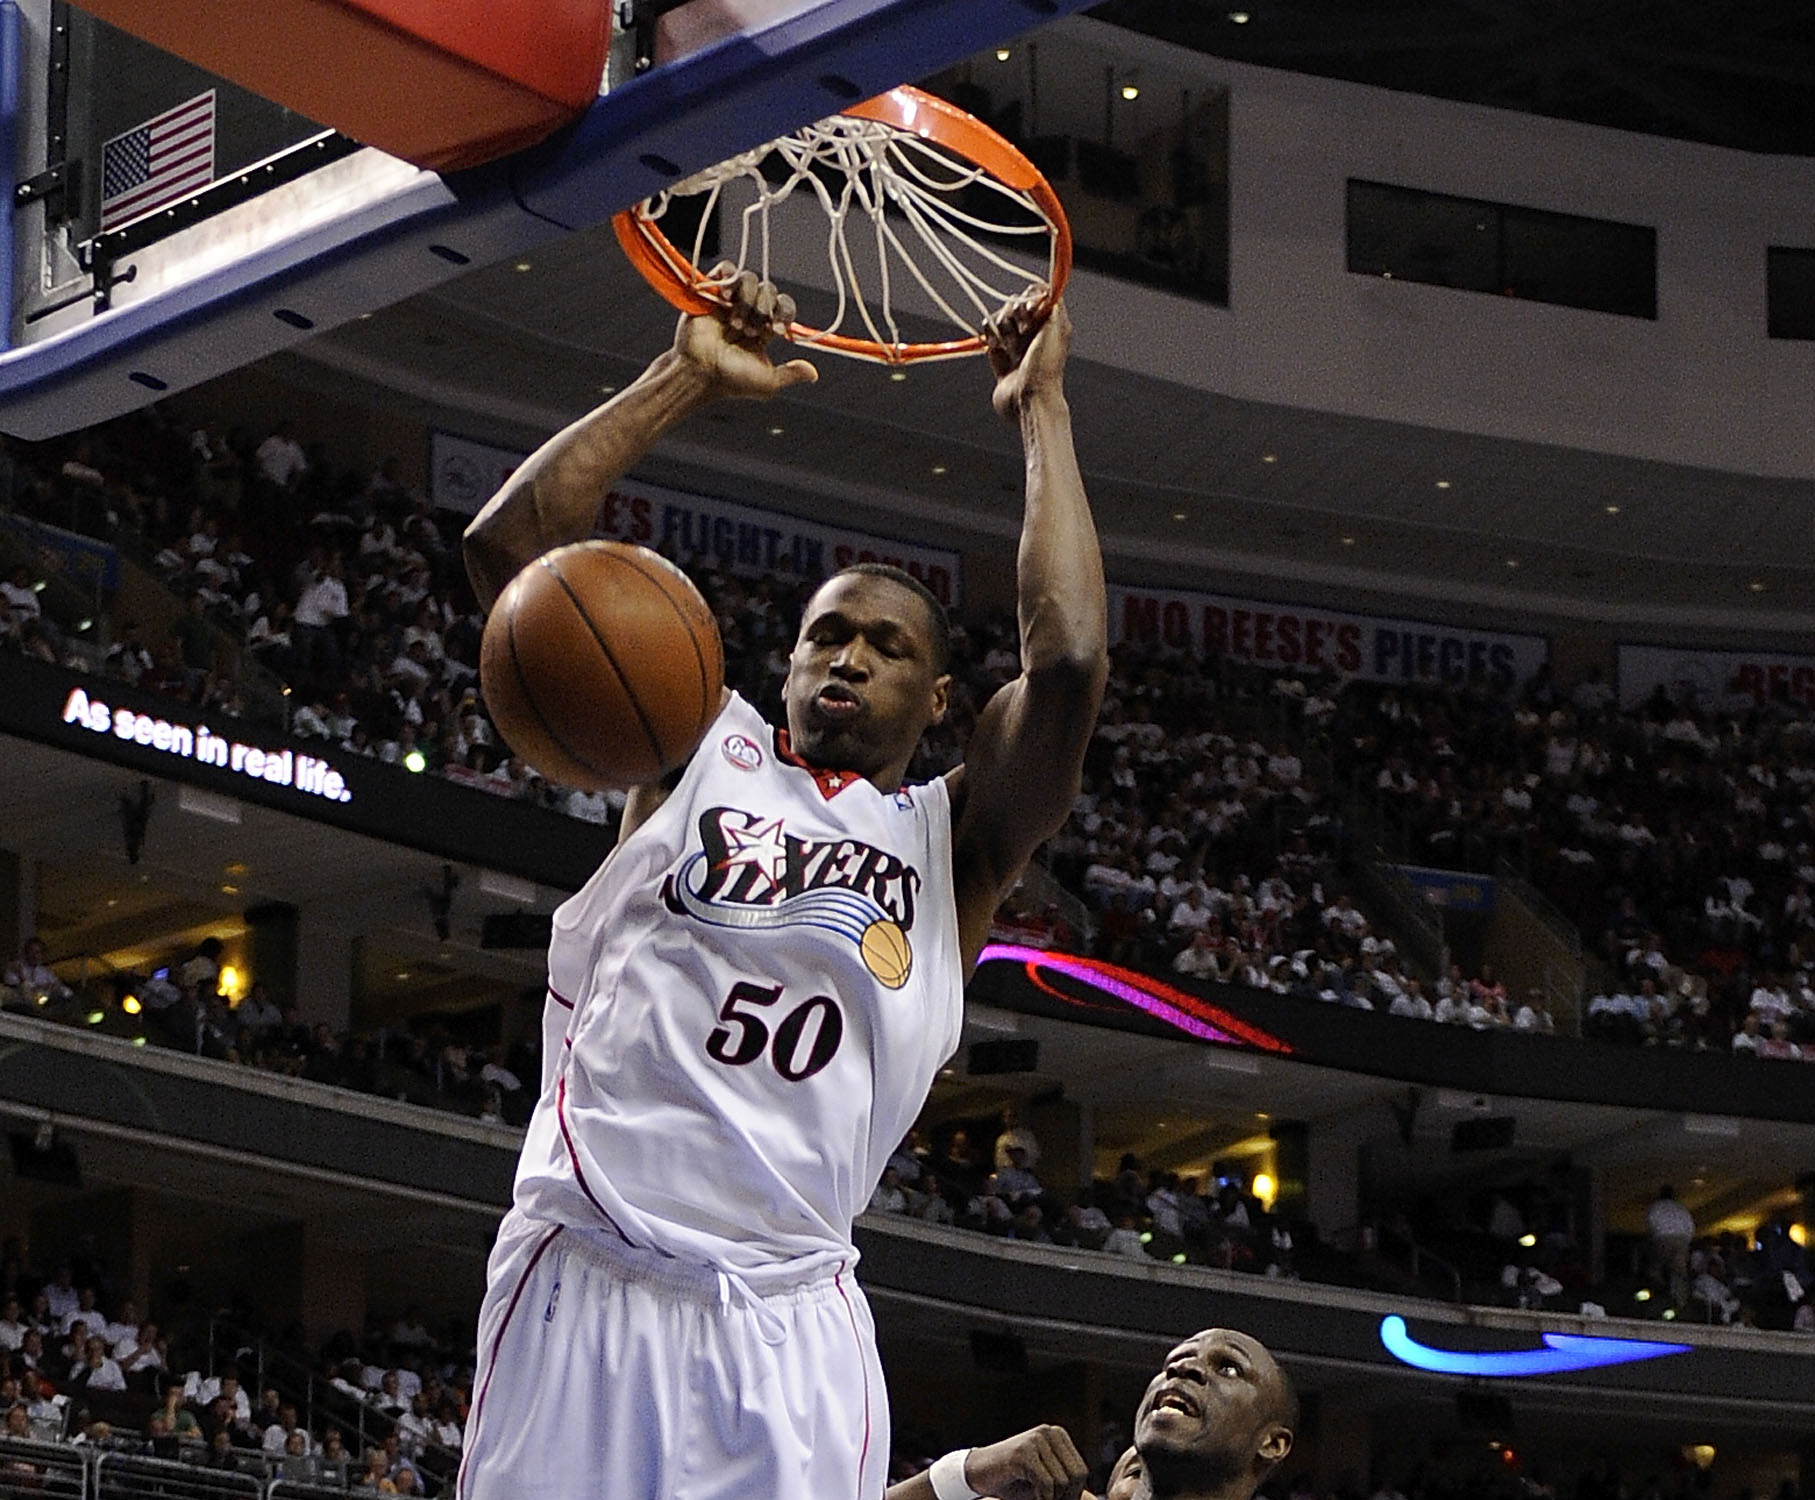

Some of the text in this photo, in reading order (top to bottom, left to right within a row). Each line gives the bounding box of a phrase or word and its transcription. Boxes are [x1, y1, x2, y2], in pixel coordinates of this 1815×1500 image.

[1203, 605, 1362, 672] REESE'S
[1376, 629, 1516, 686] PIECES
[62, 687, 352, 802] As seen in real life.
[659, 806, 921, 931] SIXERS
[706, 981, 843, 1082] 50
